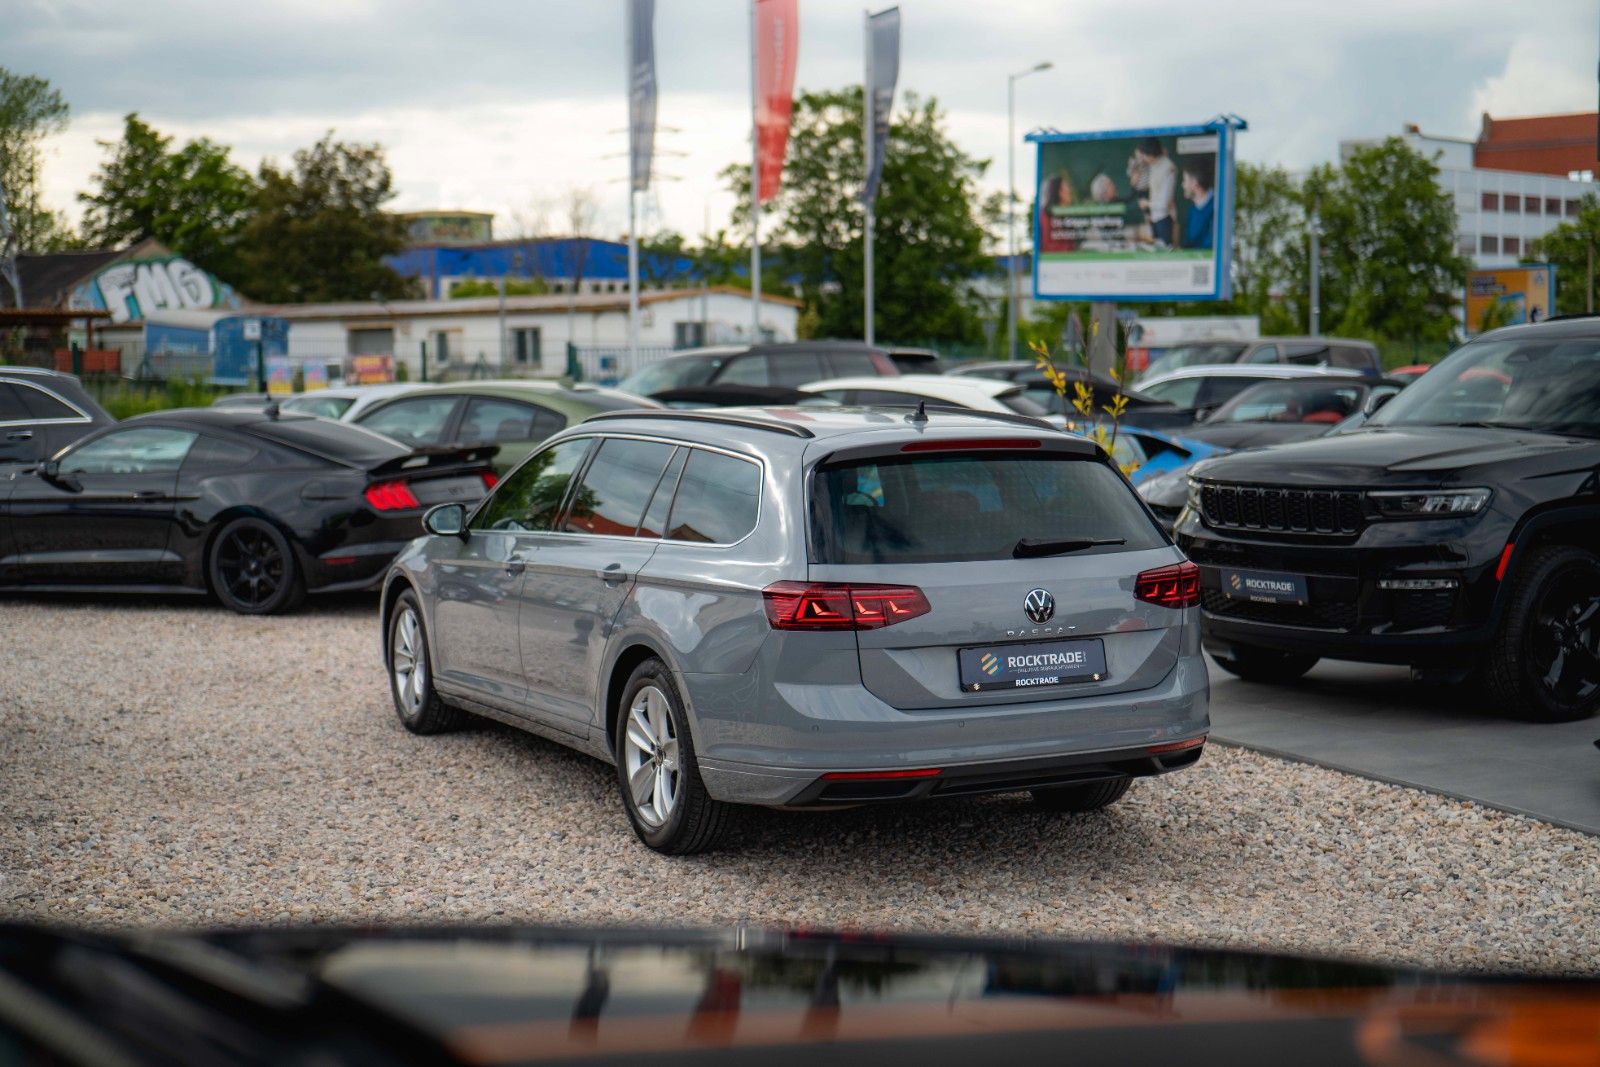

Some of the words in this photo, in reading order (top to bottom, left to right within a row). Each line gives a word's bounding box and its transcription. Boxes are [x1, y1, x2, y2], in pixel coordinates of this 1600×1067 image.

[1245, 579, 1292, 591] ROCKTRADE
[1007, 626, 1076, 636] PASSAT
[1007, 651, 1083, 667] ROCKTRADE
[1015, 676, 1059, 686] ROCKTRADE
